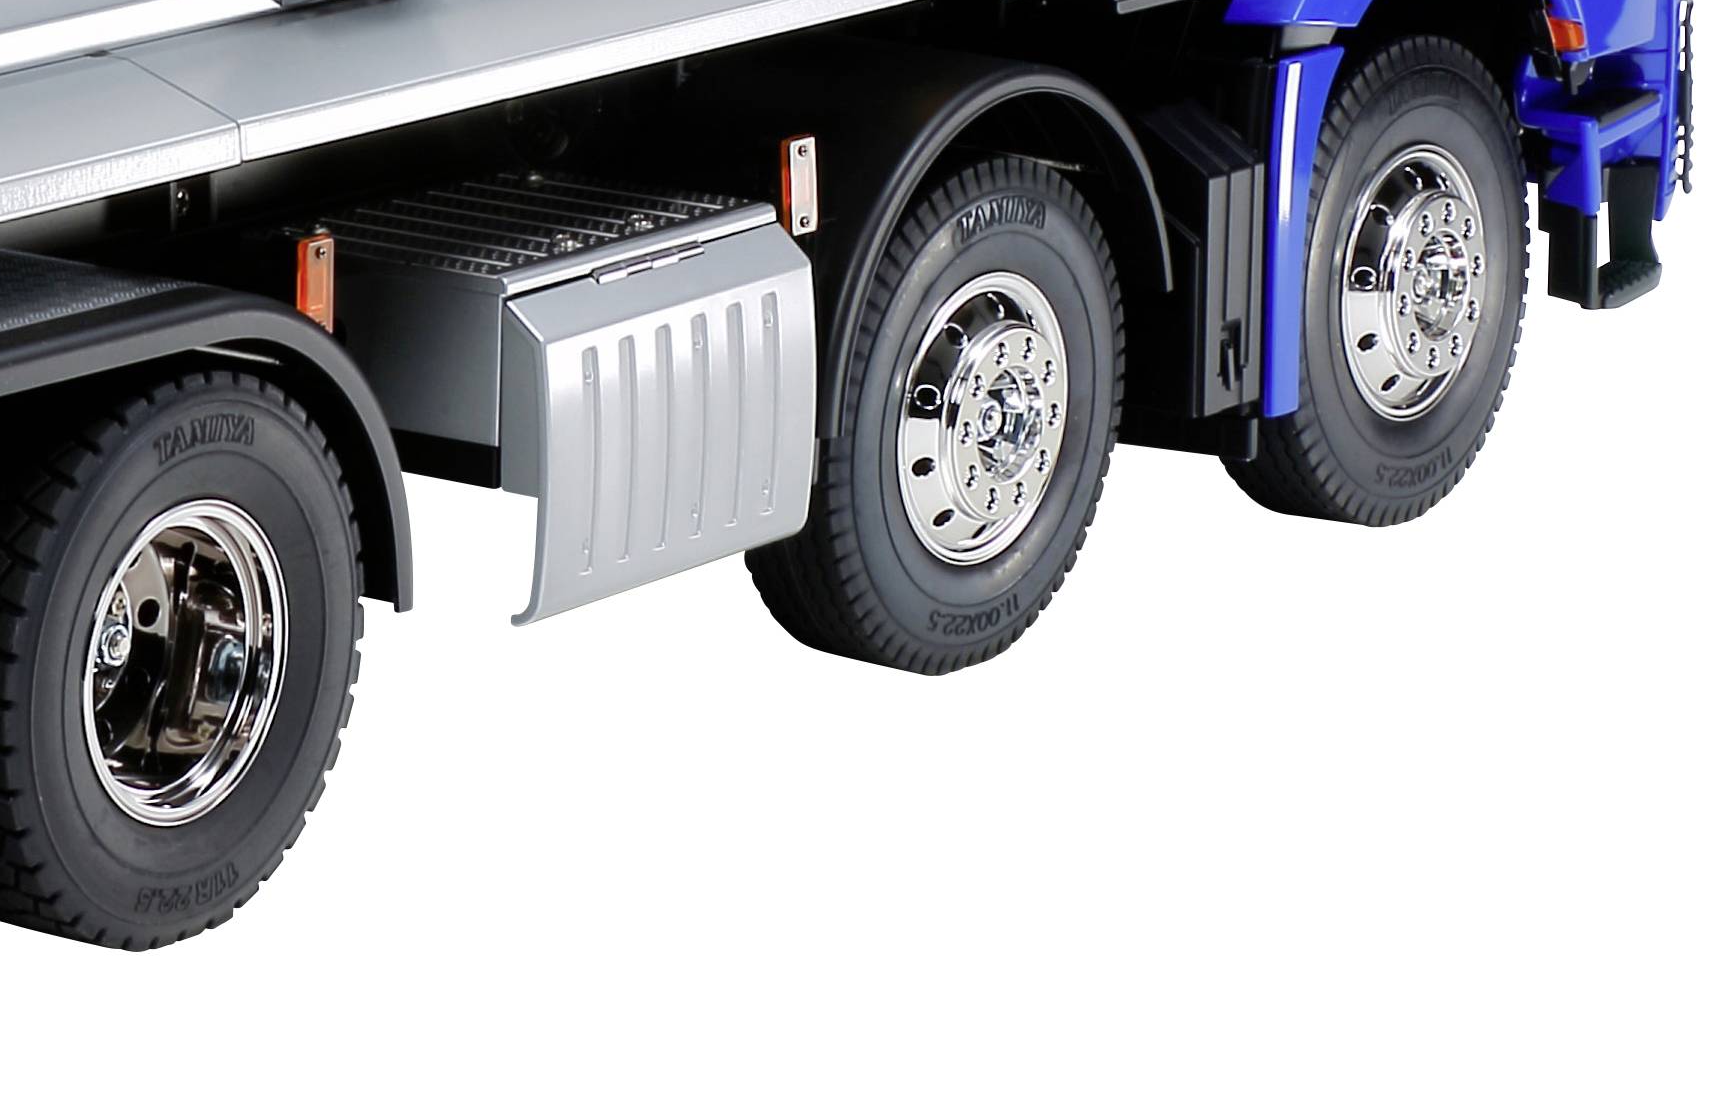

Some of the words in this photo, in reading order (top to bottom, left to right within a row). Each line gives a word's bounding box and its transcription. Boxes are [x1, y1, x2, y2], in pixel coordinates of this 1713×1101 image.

[957, 195, 1046, 245] TAMIYA
[151, 412, 256, 467] TAMIYA
[927, 593, 1019, 637] 11.00X22.5
